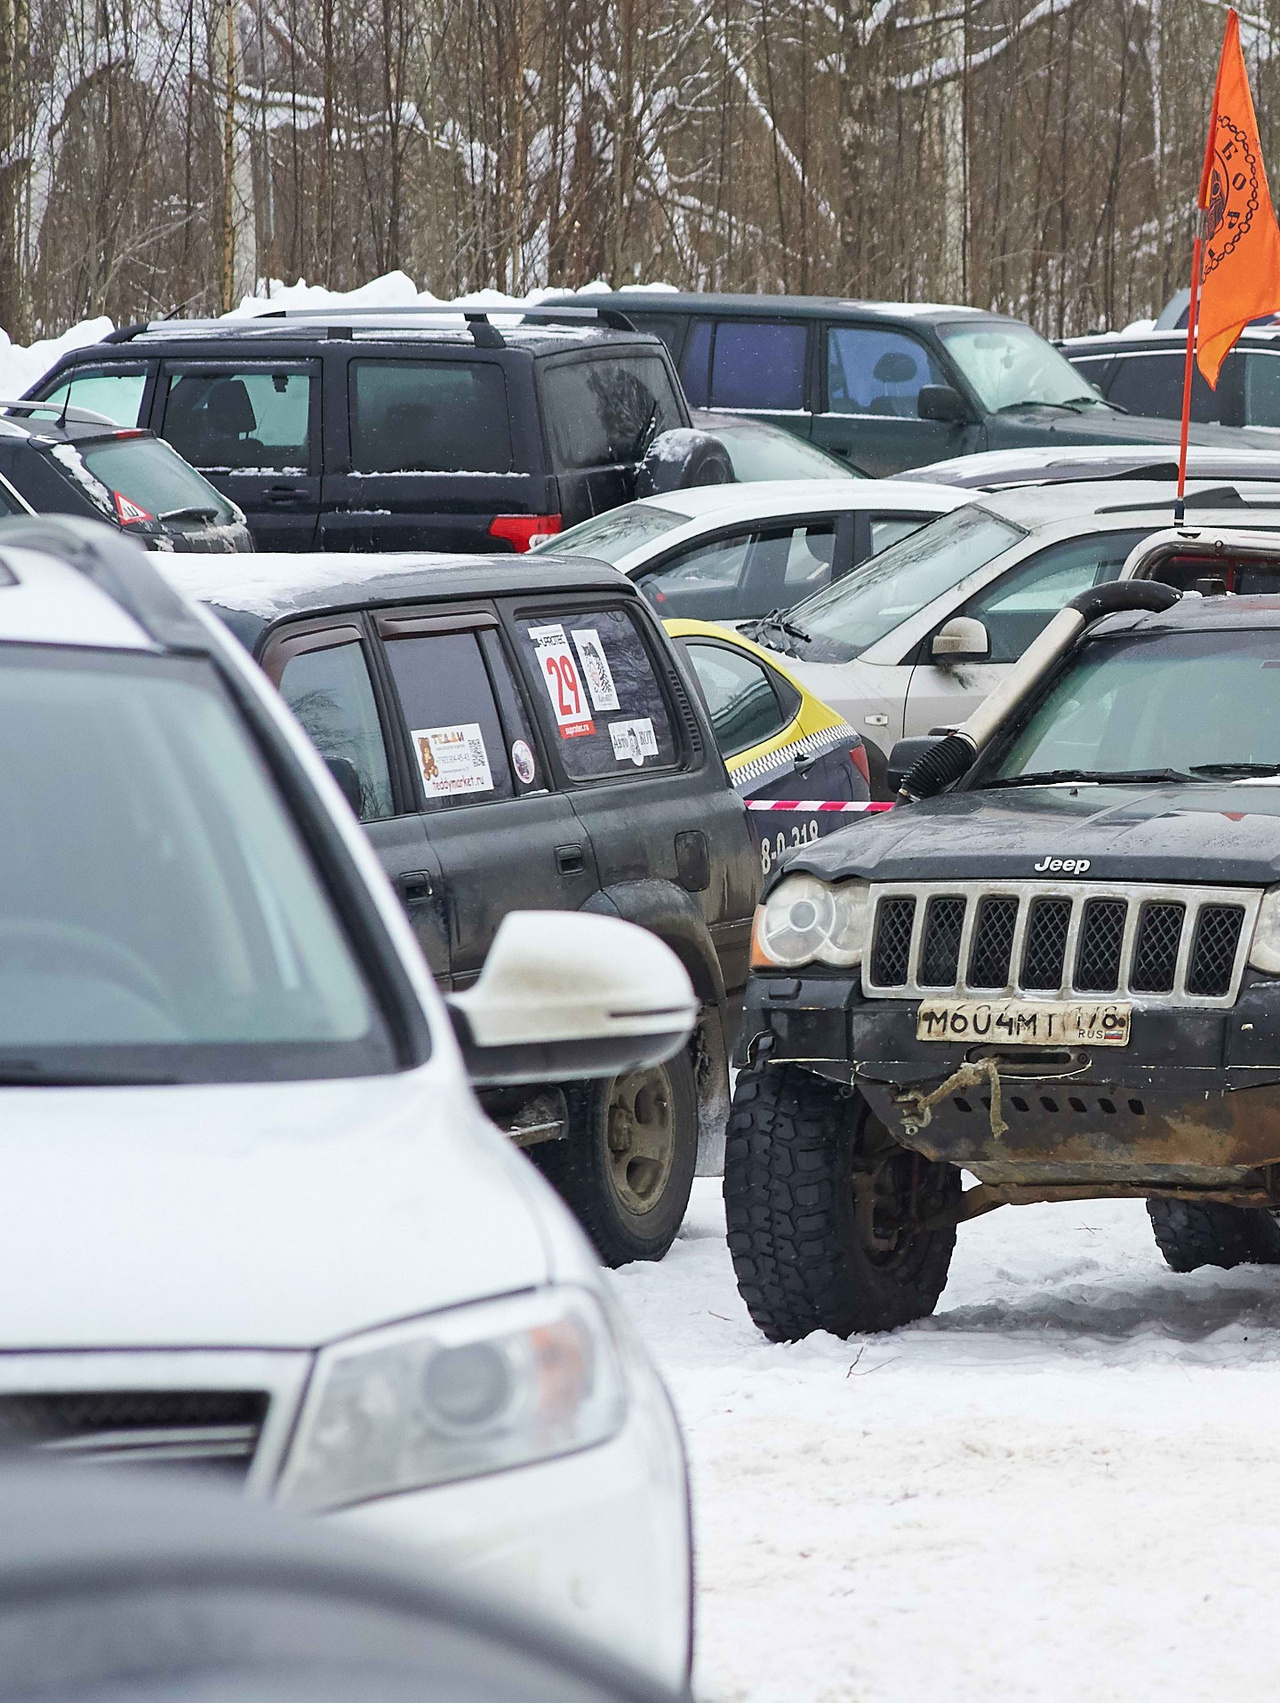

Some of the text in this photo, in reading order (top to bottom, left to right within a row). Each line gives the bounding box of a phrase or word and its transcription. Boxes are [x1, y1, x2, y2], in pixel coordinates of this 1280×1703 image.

[546, 655, 581, 716] 29
[432, 775, 484, 792] teddymarket.ru
[1034, 856, 1091, 875] Jeep
[1078, 1029, 1103, 1040] RUS
